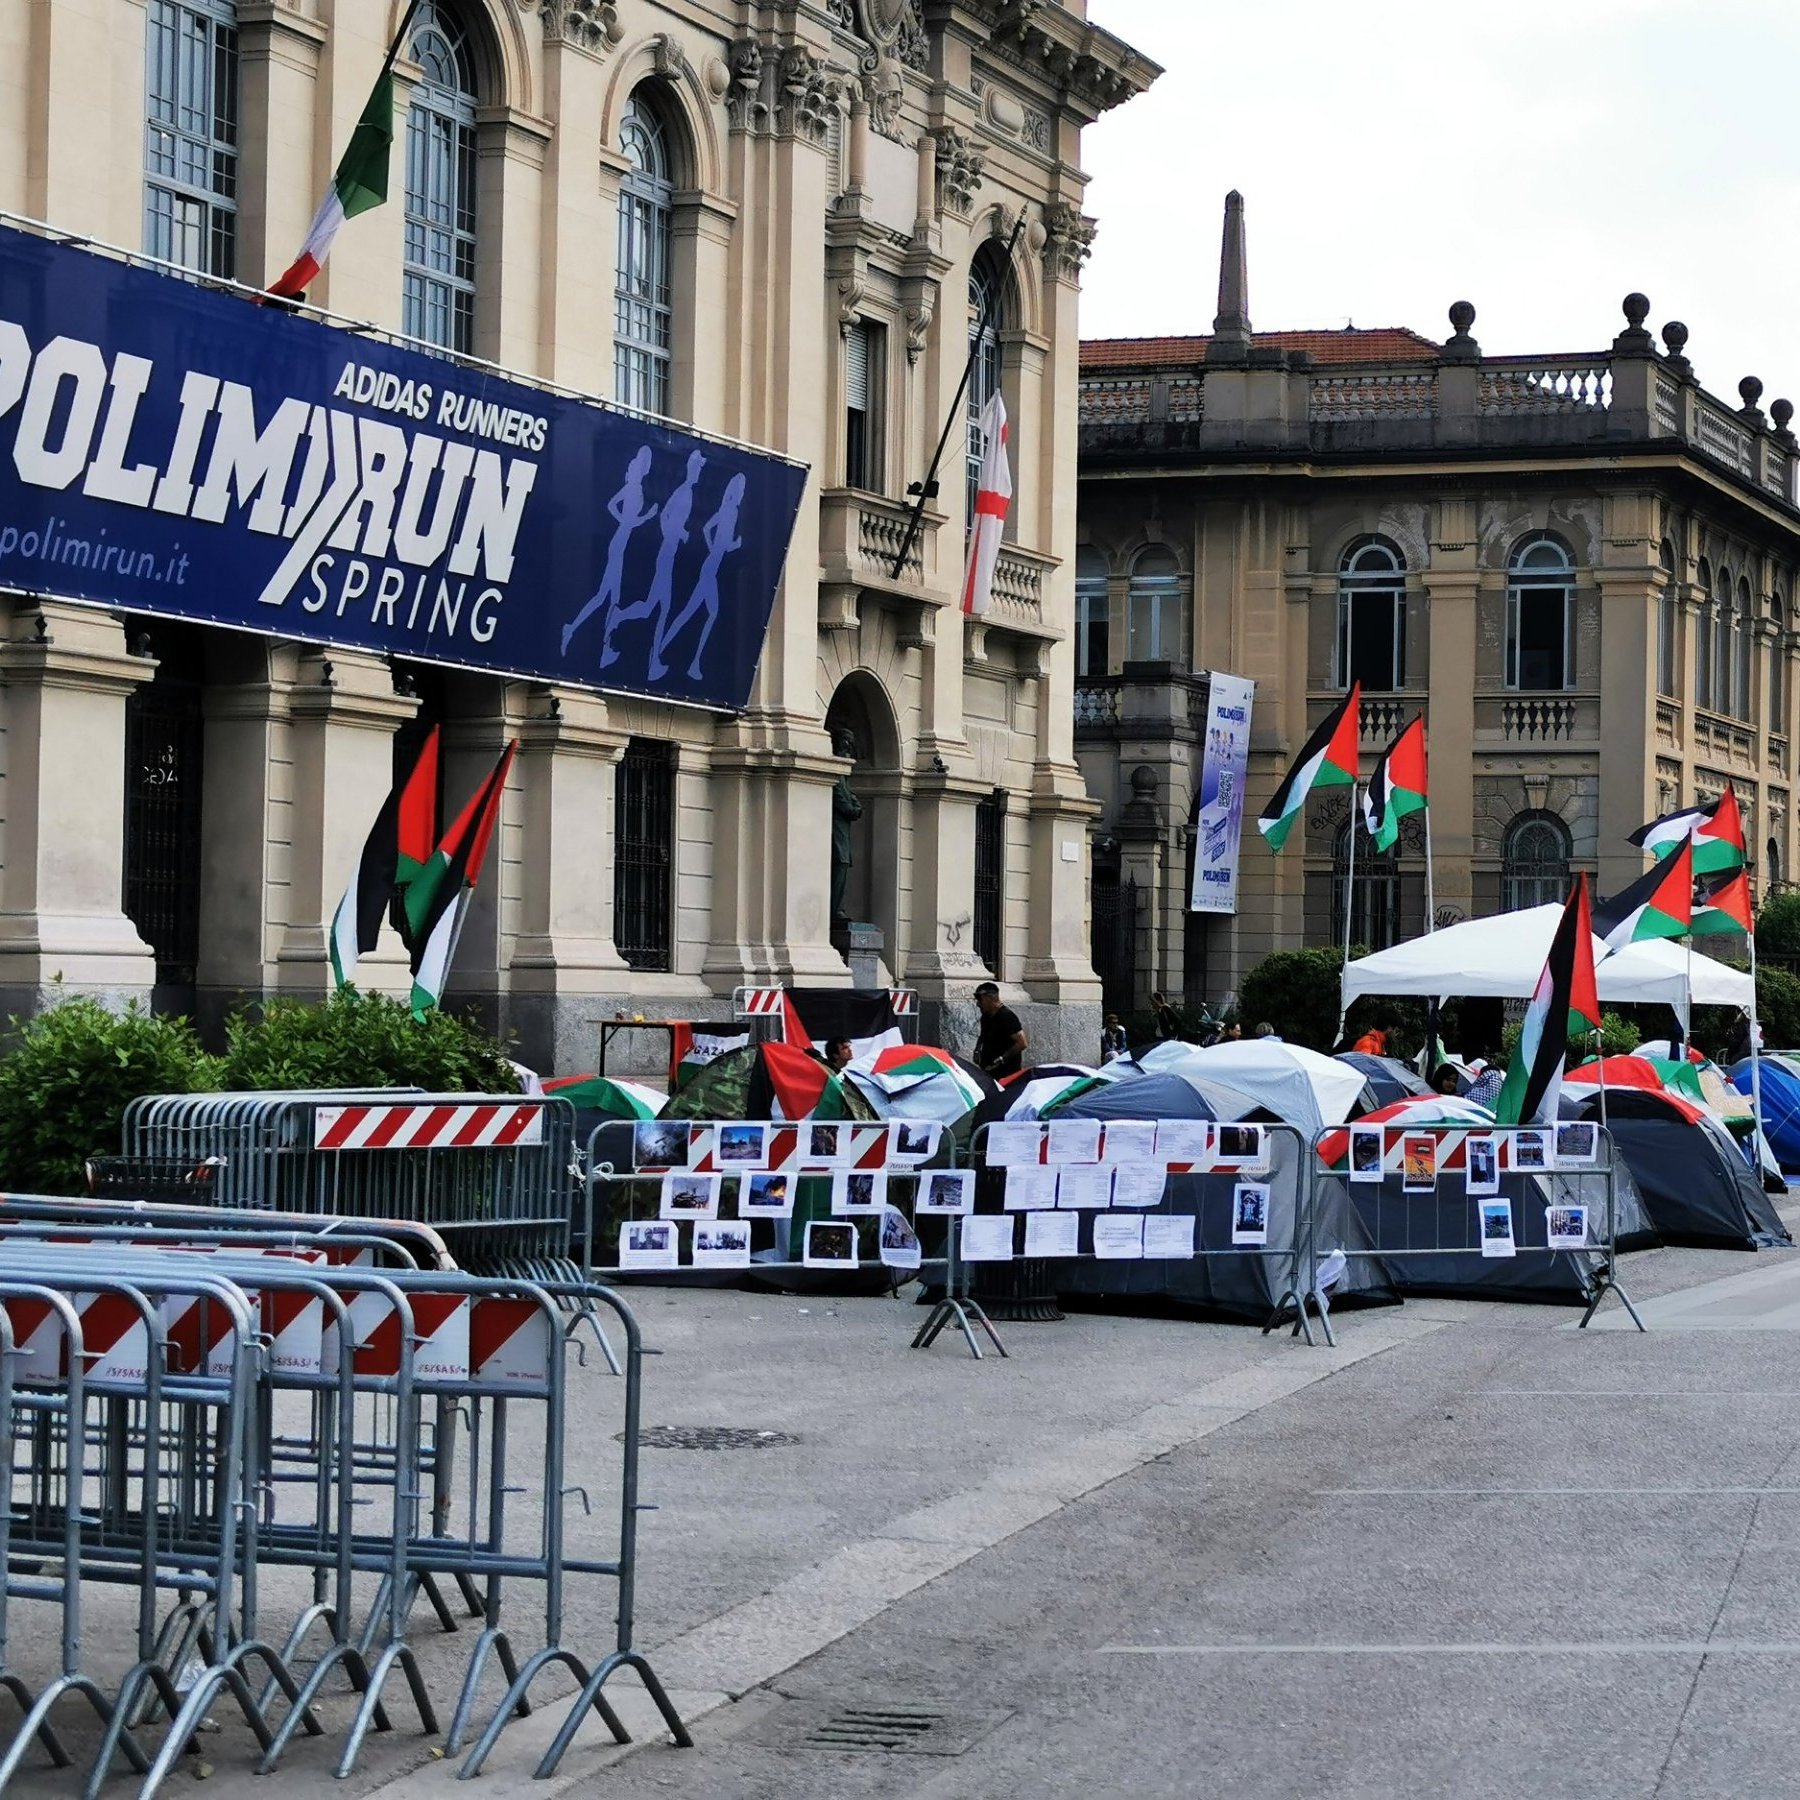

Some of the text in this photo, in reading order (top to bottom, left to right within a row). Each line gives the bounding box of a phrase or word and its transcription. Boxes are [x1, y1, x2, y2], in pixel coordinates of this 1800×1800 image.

[333, 361, 549, 452] ADIDAS RUNNERS
[301, 552, 503, 643] SPRING
